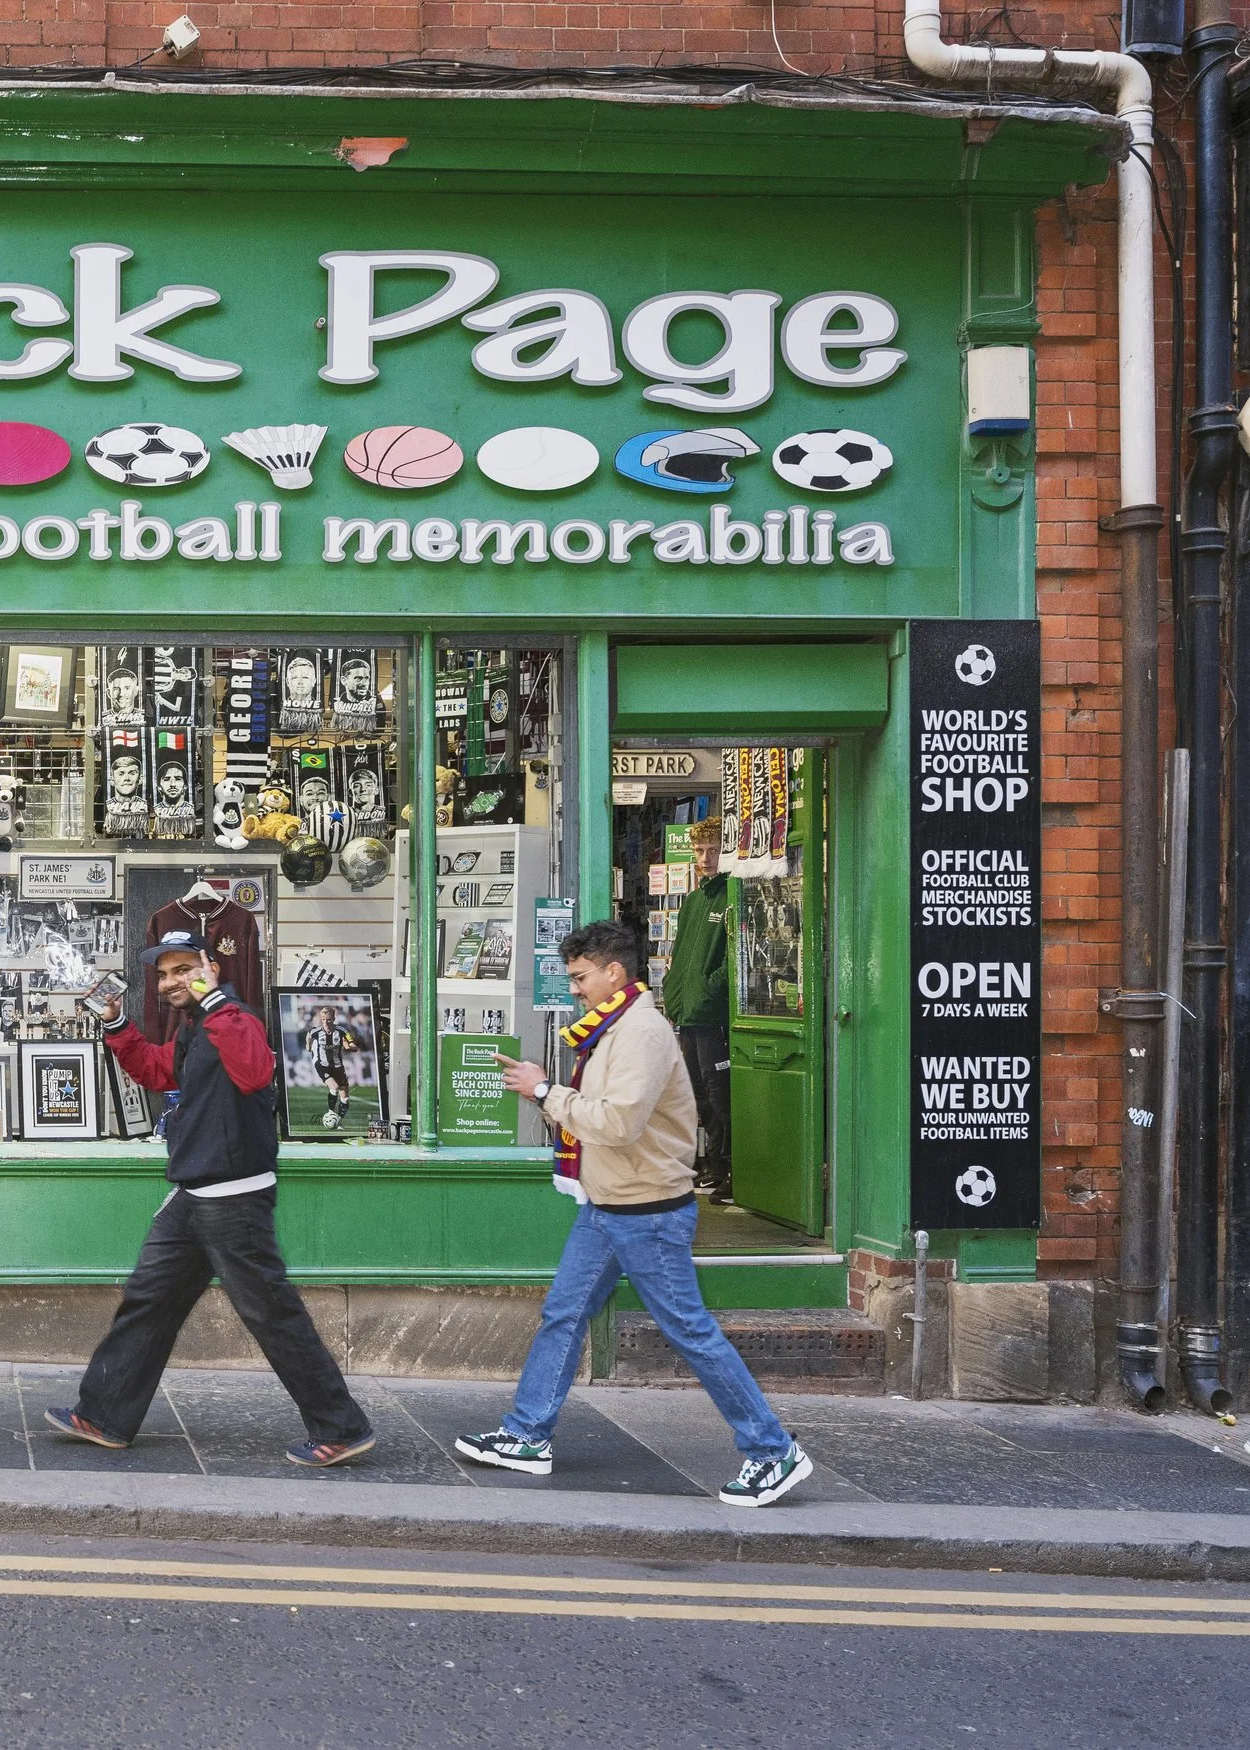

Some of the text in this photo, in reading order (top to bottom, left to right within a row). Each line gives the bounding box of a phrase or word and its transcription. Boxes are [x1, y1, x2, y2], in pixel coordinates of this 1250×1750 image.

[318, 250, 909, 413] Page
[323, 504, 895, 566] memorabilia
[436, 687, 465, 697] HOWAY
[283, 700, 321, 709] HOWE
[443, 703, 457, 711] THE
[439, 718, 460, 728] LADS
[921, 710, 1028, 731] WORLD'S
[921, 733, 1028, 752] FAVOURITE
[647, 757, 687, 773] PARK
[921, 754, 1029, 774] FOOTBALL
[921, 777, 1029, 812] SHOP
[668, 833, 683, 843] The
[921, 850, 1029, 872] OFFICIAL
[29, 864, 72, 873] ST. JAMES'
[29, 874, 67, 883] PARK NE1
[922, 874, 1029, 887] FOOTBALL CLUB
[922, 890, 1031, 905] MERCHANDISE
[922, 906, 1031, 926] STOCKISTS
[918, 961, 1031, 999] OPEN
[921, 1003, 1028, 1017] 7 DAYS A WEEK
[921, 1057, 1031, 1079] WANTED
[48, 1069, 72, 1080] PUMP
[48, 1080, 58, 1091] IT
[452, 1080, 506, 1089] EACH OTHER
[49, 1091, 60, 1101] UP
[454, 1089, 503, 1098] SINCE 2003
[921, 1084, 1030, 1109] WE BUY
[457, 1100, 480, 1111] Thank
[456, 1118, 500, 1127] Shop online:
[921, 1113, 1030, 1125] YOUR UNWANTED
[442, 1127, 513, 1135] www.backpagenewcastle.com
[921, 1127, 1029, 1140] FOOTBALL ITEMS
